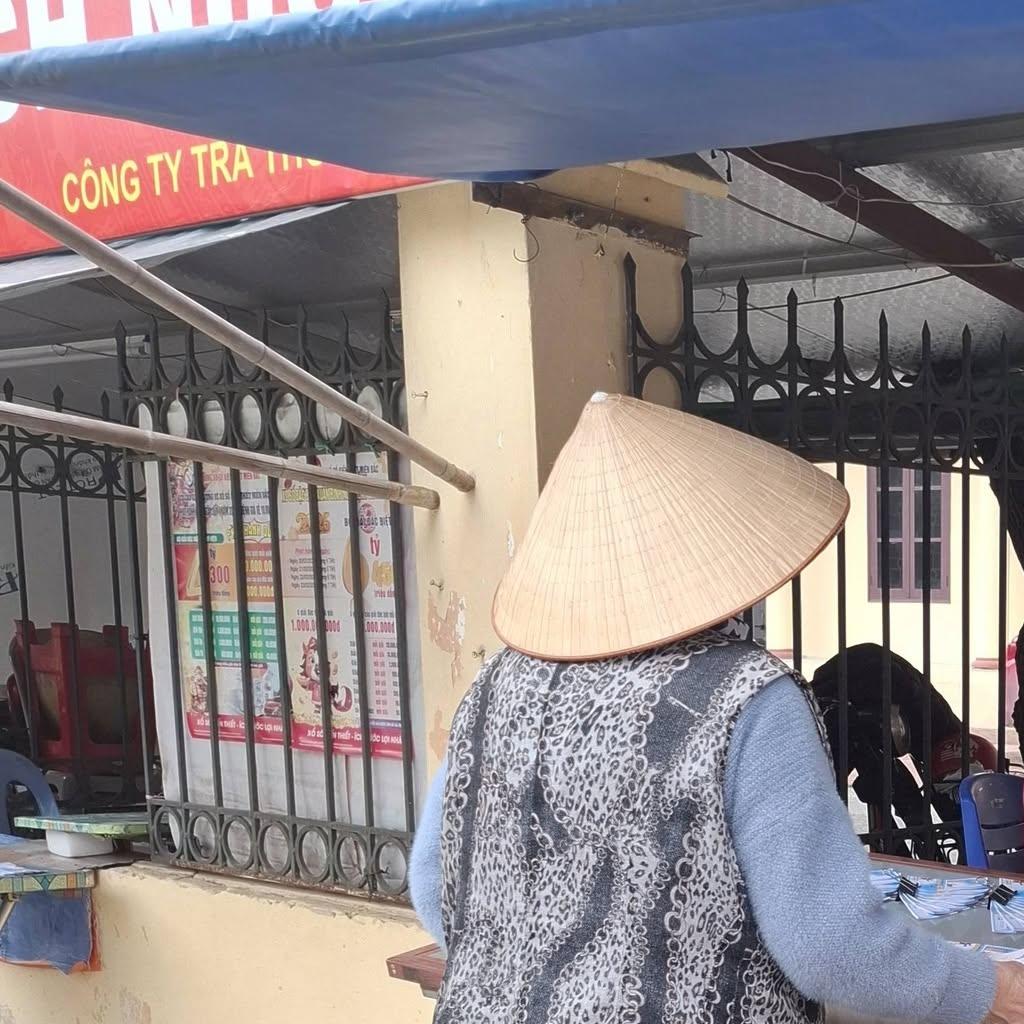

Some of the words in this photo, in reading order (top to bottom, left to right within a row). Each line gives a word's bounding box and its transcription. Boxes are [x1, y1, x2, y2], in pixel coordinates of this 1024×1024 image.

[62, 159, 141, 213] CÔNG
[147, 149, 182, 196] TY
[209, 565, 230, 583] 300
